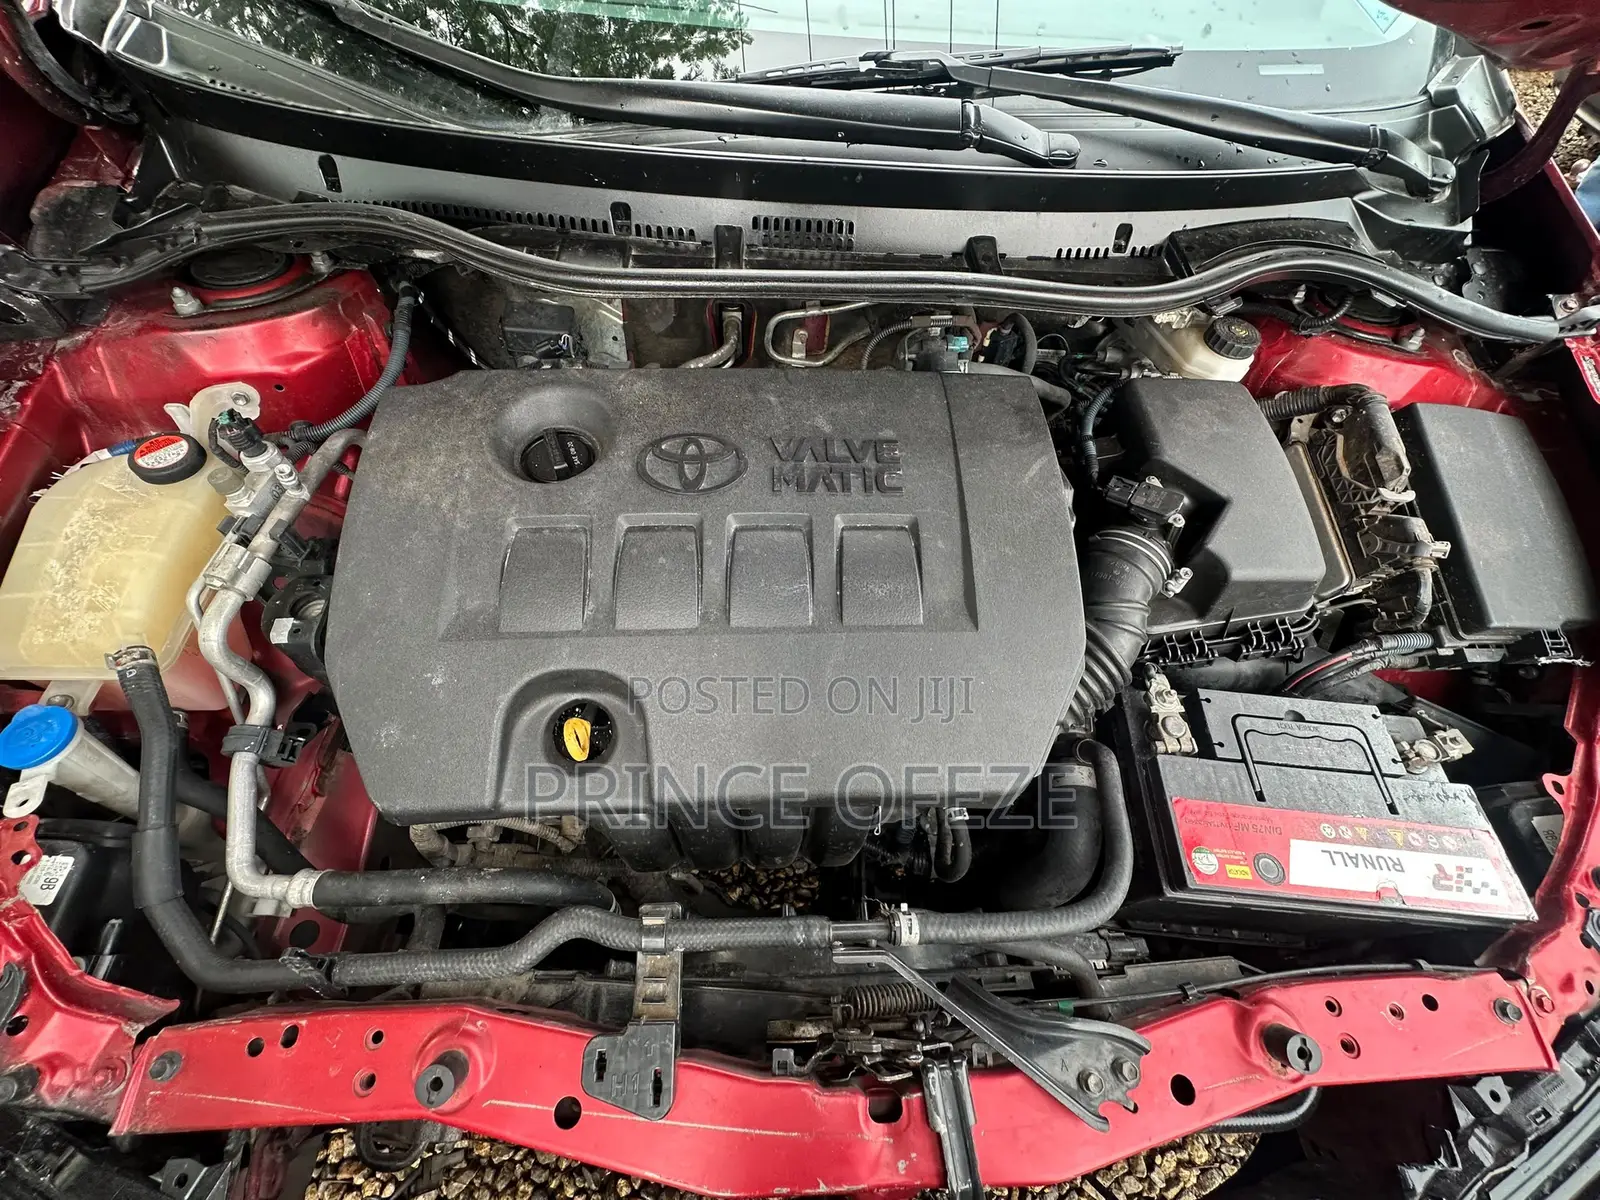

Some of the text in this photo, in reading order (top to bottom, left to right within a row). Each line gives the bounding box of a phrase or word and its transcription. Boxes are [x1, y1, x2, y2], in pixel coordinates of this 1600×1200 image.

[768, 436, 901, 463] VALVE
[771, 465, 904, 494] MATIC
[1320, 848, 1406, 874] RUNALL
